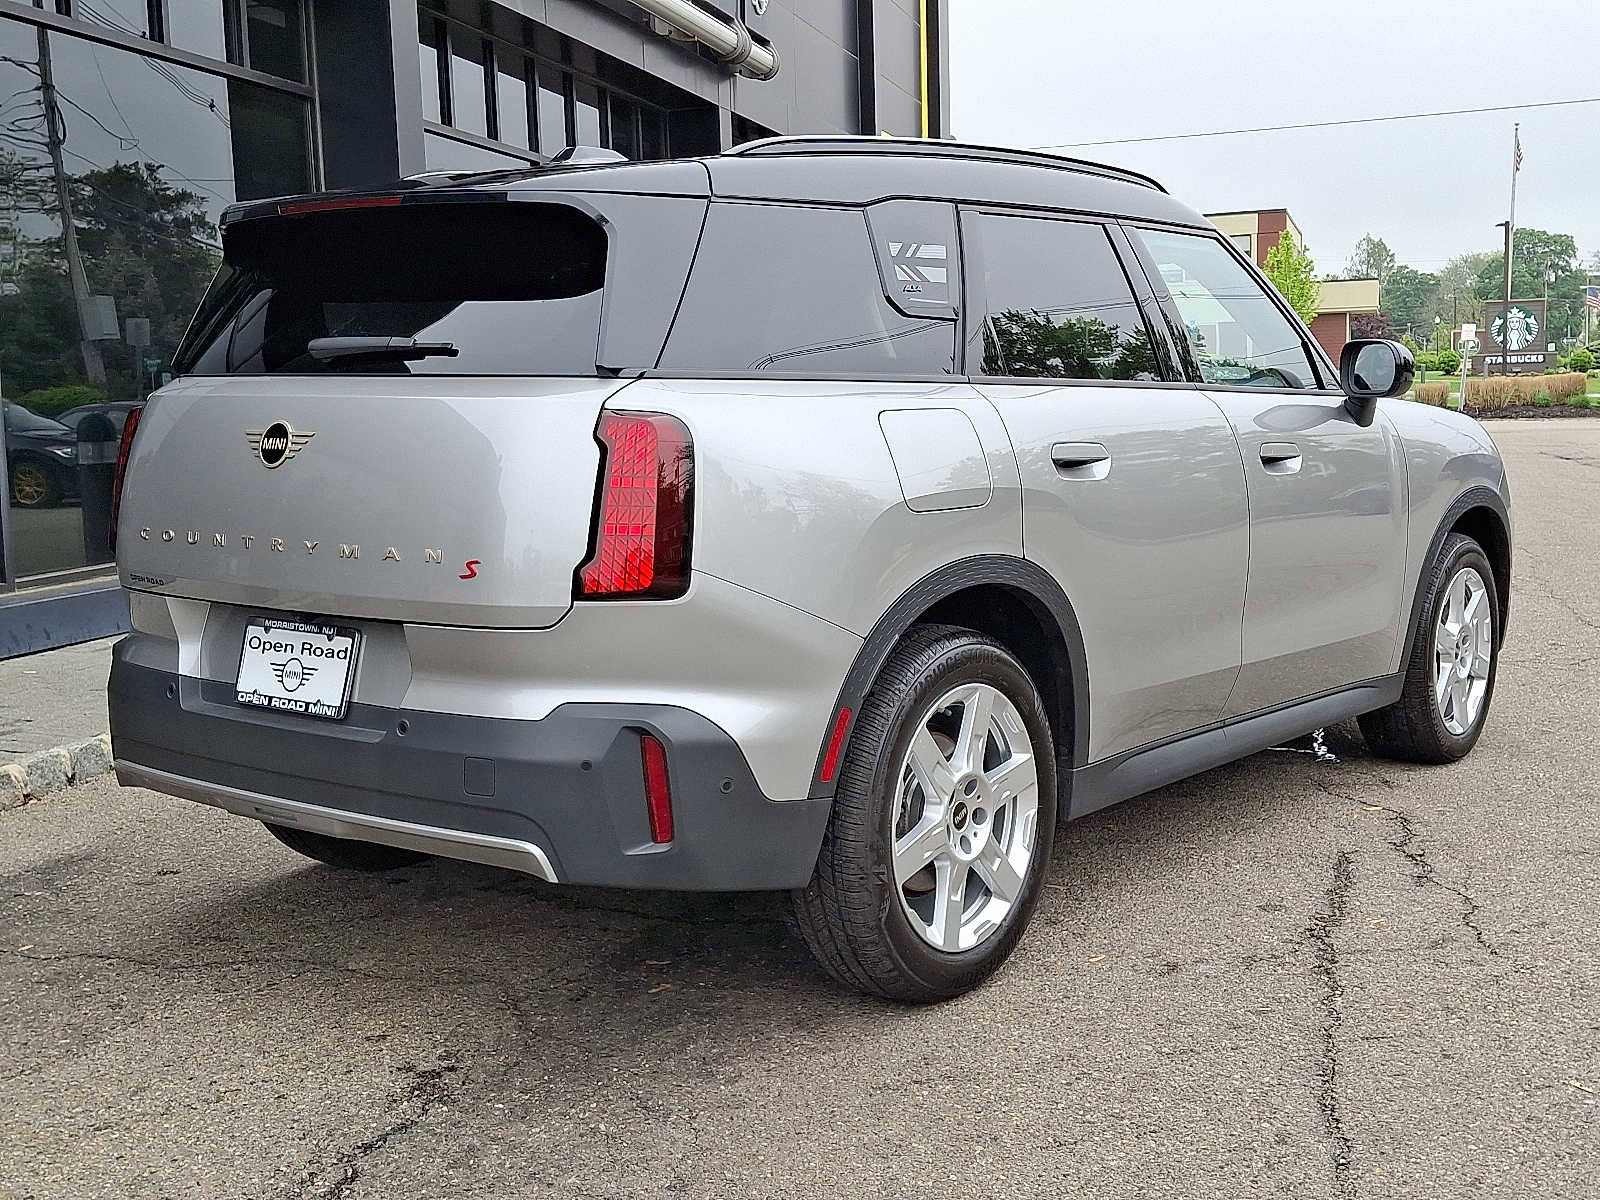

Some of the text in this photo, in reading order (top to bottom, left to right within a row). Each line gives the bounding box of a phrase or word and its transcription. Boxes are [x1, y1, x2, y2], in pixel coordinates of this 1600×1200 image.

[262, 437, 287, 450] MINI
[139, 527, 443, 564] COUNTRYMAN
[459, 559, 481, 580] S
[322, 626, 334, 635] NJ
[248, 635, 349, 660] Open Road
[284, 669, 301, 681] MINI
[237, 692, 337, 717] OPEN ROAD MINI
